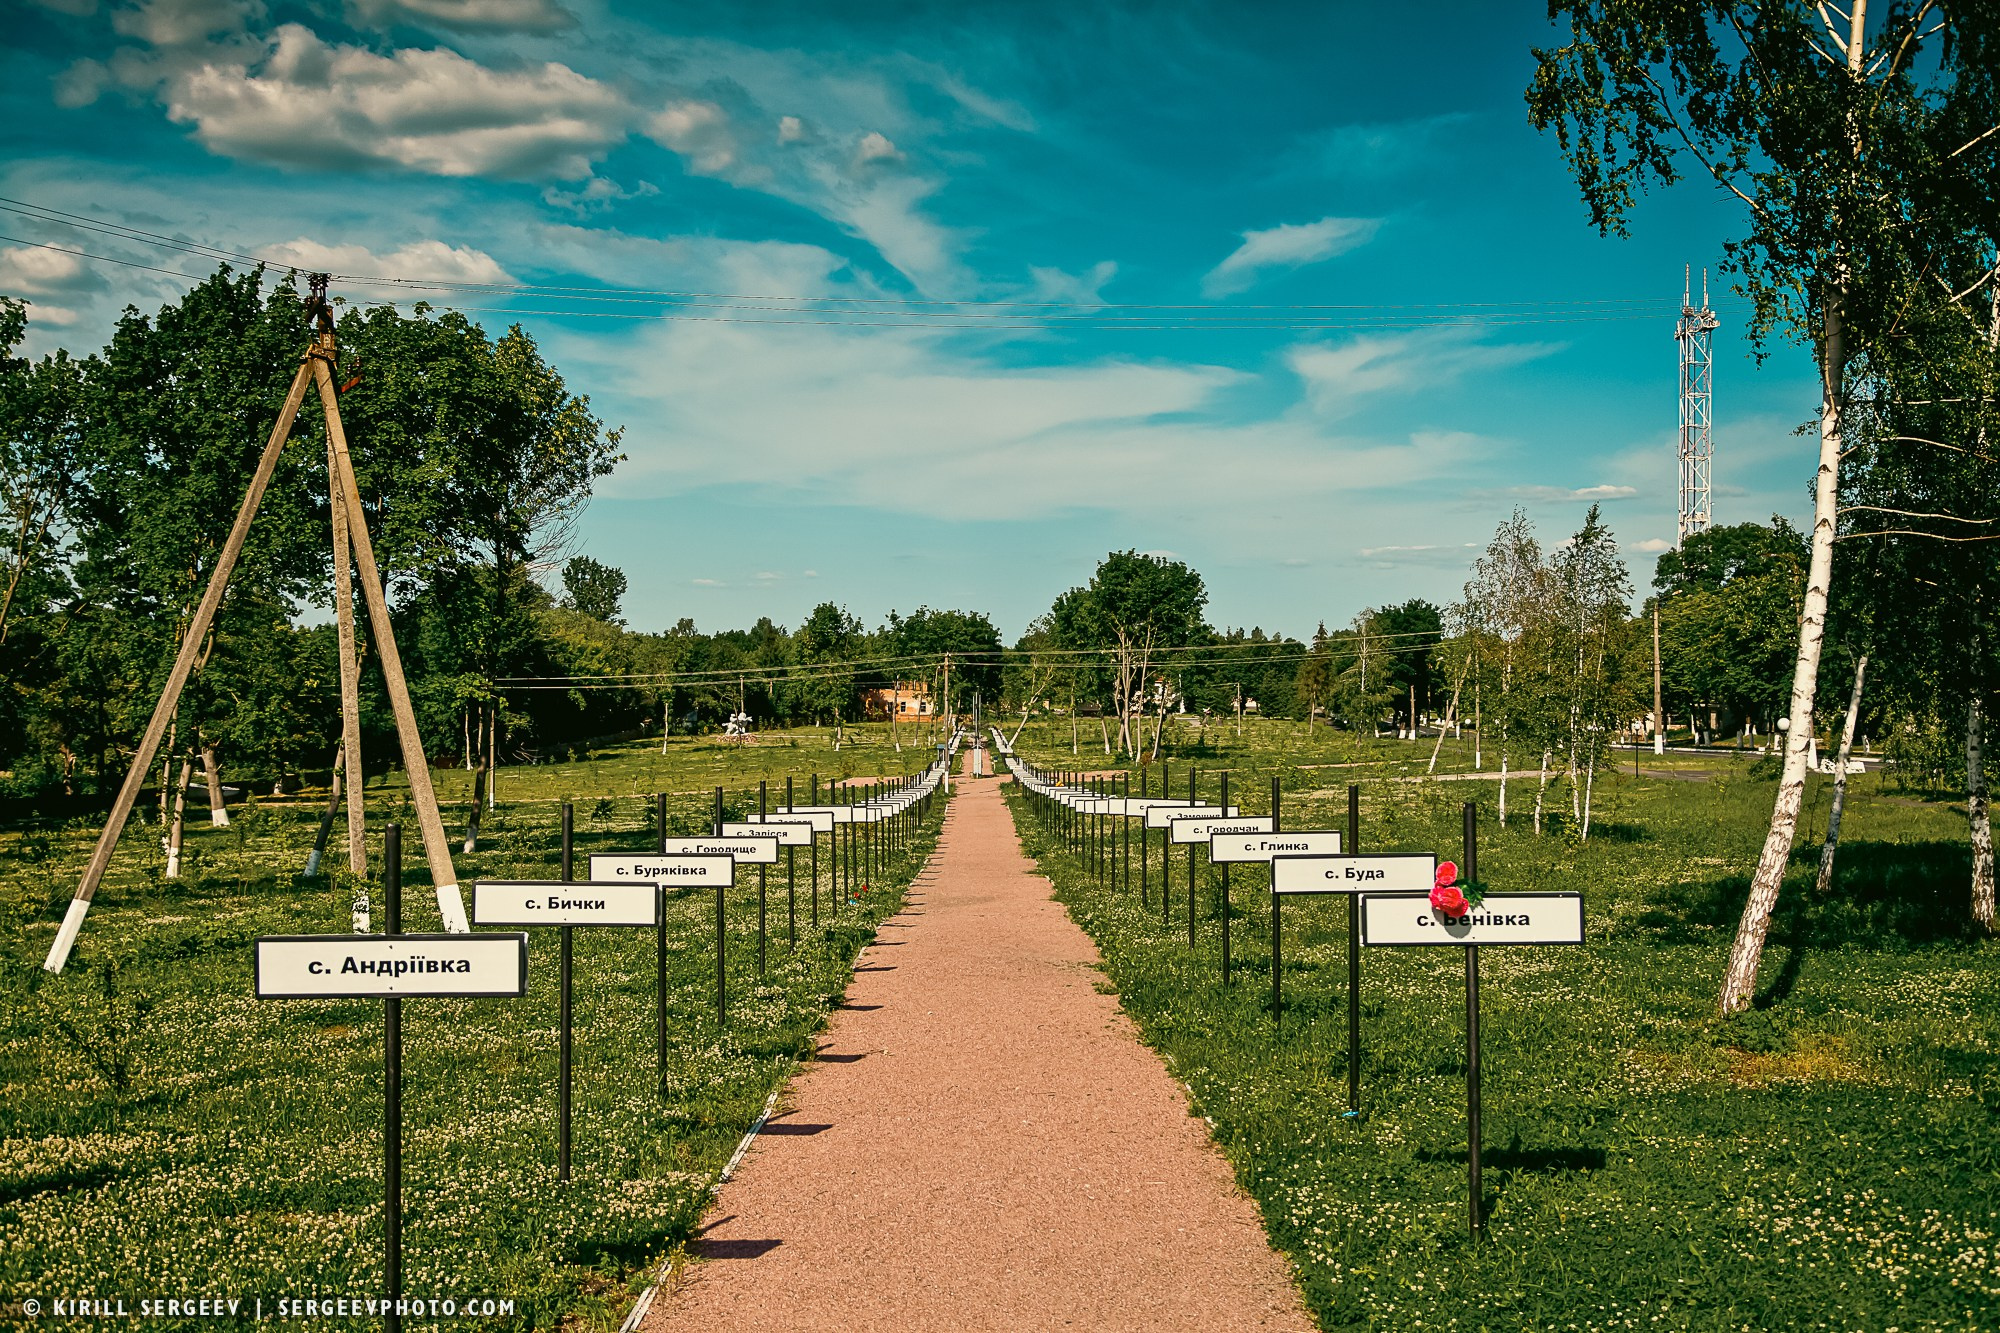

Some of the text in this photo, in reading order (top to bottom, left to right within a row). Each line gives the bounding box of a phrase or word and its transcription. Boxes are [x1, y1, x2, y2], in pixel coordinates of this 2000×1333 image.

[696, 845, 757, 854] Городище
[1244, 841, 1309, 851] с. Глинка
[616, 864, 707, 878] с. Буряківка
[1325, 867, 1385, 881] с. Буда
[525, 896, 605, 910] с. Бички
[1416, 915, 1435, 926] с.
[308, 945, 471, 978] с. Андріївка
